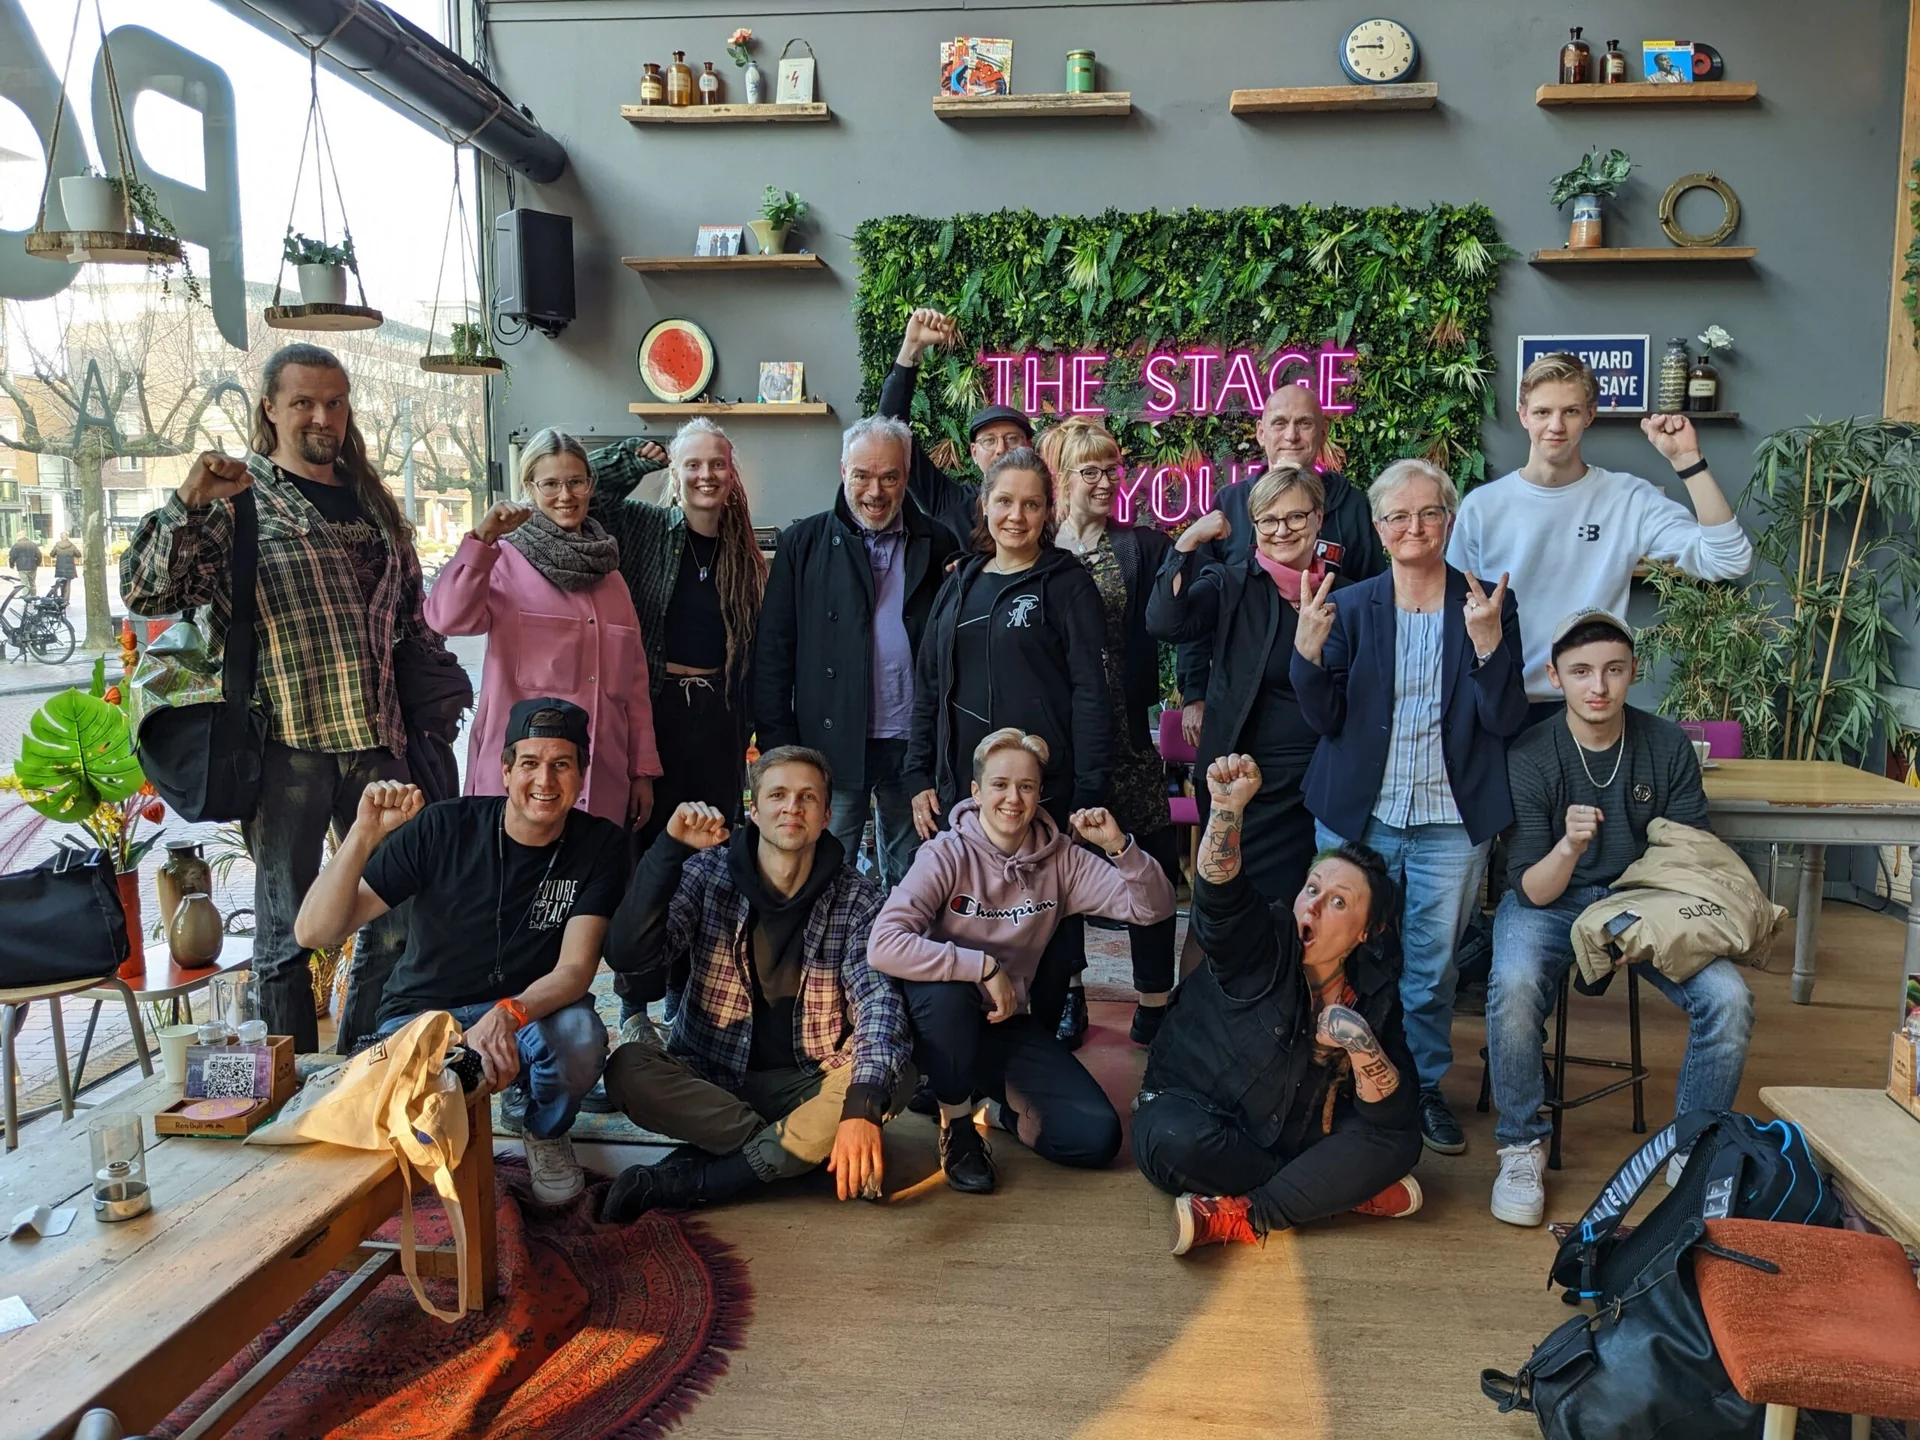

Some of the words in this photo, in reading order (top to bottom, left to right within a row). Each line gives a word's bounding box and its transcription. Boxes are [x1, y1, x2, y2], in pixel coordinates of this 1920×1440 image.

[1534, 351, 1633, 369] EVARD
[985, 356, 1106, 412] THE
[1146, 352, 1355, 412] STAGE
[1597, 376, 1638, 396] SAYE
[950, 894, 1057, 925] Champion
